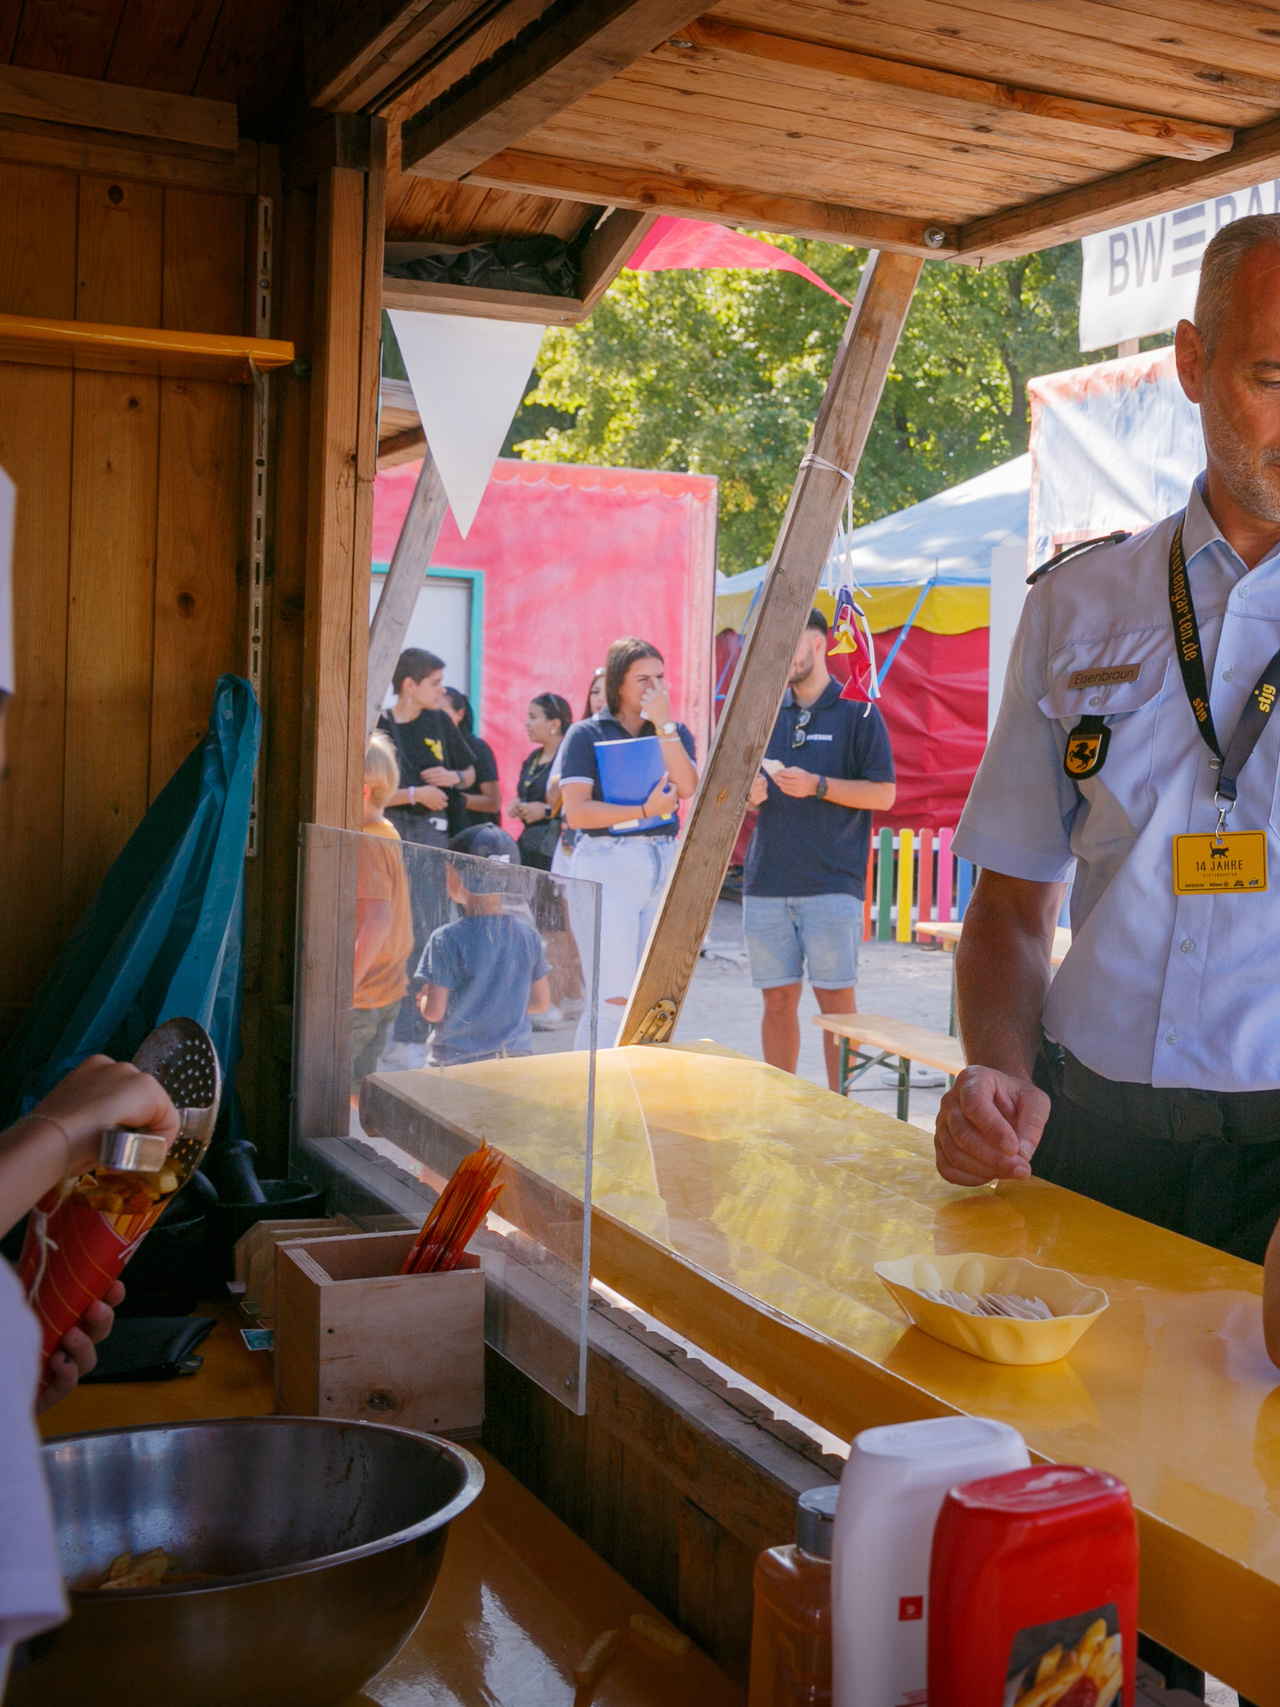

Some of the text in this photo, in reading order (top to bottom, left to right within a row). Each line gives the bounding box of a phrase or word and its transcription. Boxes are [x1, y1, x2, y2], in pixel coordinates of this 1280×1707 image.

[1074, 669, 1135, 685] Eisenbraun
[1196, 859, 1243, 872] 14 JAHRE
